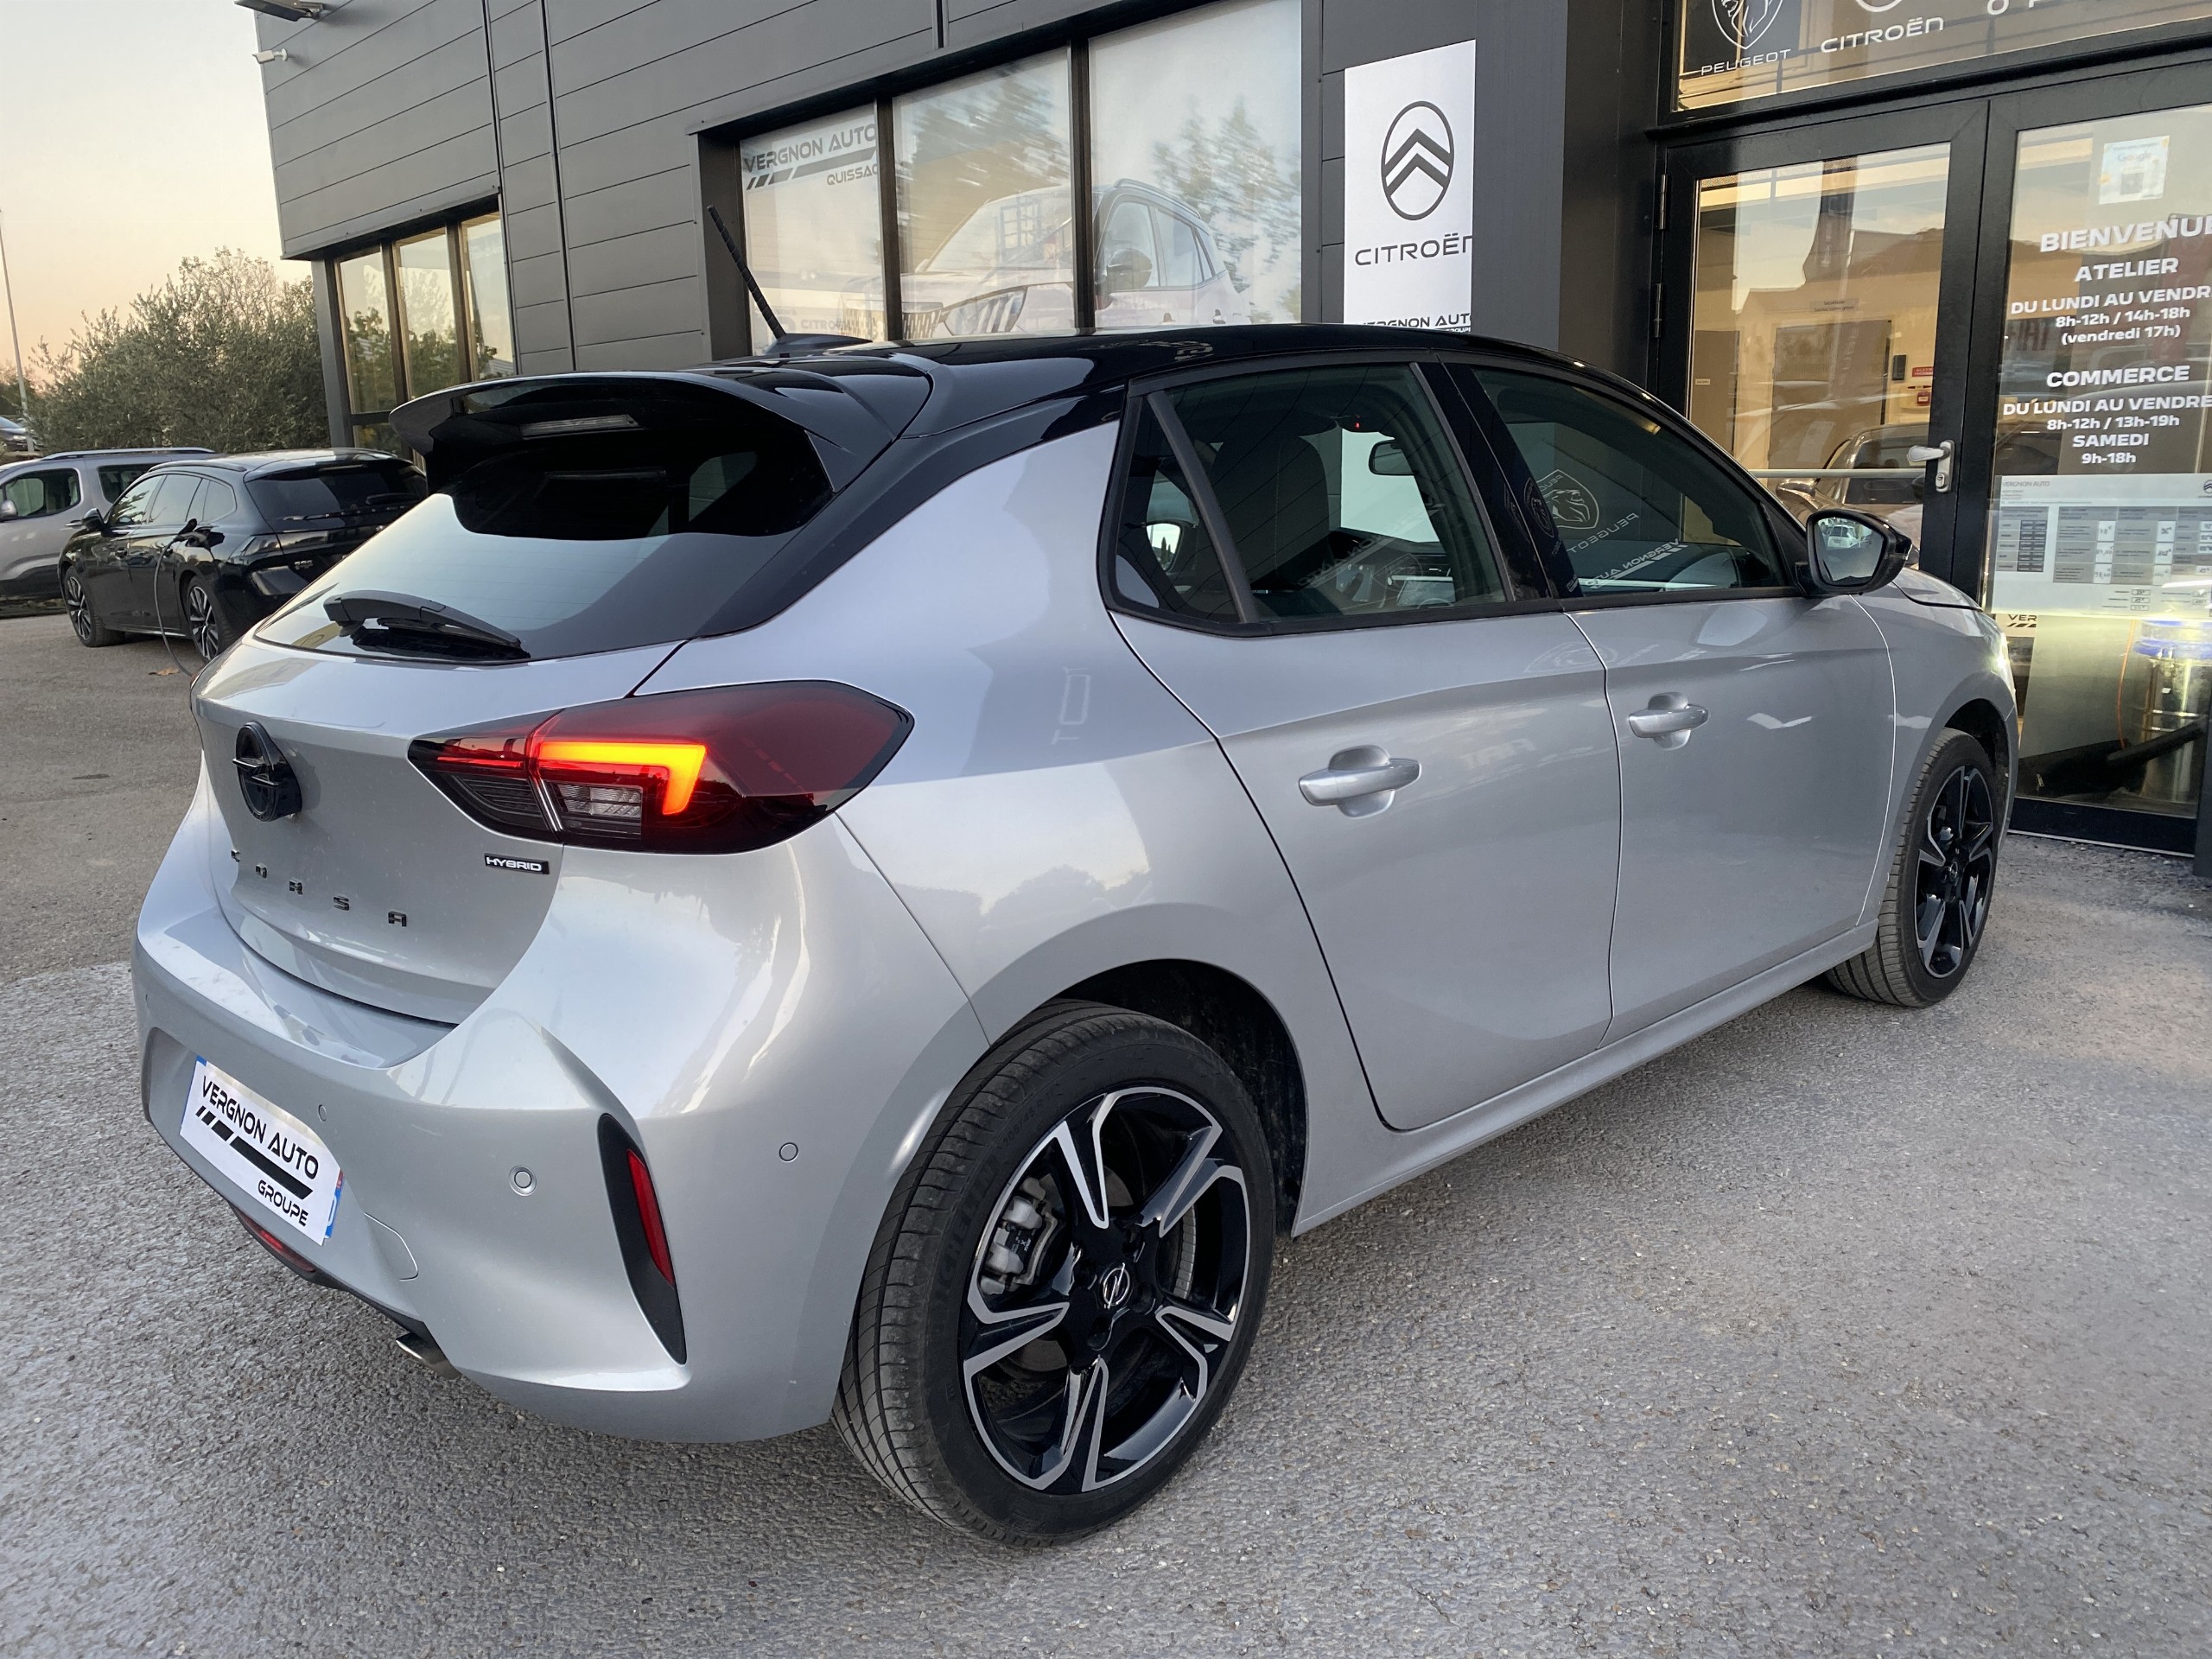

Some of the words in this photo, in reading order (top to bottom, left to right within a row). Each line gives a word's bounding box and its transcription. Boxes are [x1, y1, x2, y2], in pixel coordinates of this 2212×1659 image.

[1821, 17, 1944, 54] CITROËN
[1701, 48, 1791, 76] PEUGEOT
[744, 137, 823, 173] VERGNON
[2075, 257, 2179, 283] ATELIER
[2011, 301, 2037, 315] DU
[2042, 295, 2100, 312] LUNDI
[2103, 292, 2133, 308] AU
[1435, 312, 1471, 326] AUT
[2056, 314, 2110, 328] 8h-12h
[2125, 306, 2191, 322] 14h-18h
[2062, 327, 2140, 346] (vendredi
[2145, 325, 2182, 340] 17h)
[2046, 365, 2190, 388] COMMERCE
[2003, 402, 2030, 416] DU
[2033, 399, 2091, 415] LUNDI
[2094, 397, 2125, 412] AU
[2046, 417, 2101, 430] 8h-12h
[2114, 415, 2180, 429] 13h-19h
[2073, 433, 2150, 448] SAMEDI
[2082, 452, 2137, 464] 9h-18h
[486, 855, 543, 873] HYBRID
[202, 1075, 267, 1144] VERGNON
[267, 1132, 319, 1180] AUTO
[257, 1179, 309, 1227] GROUPE
